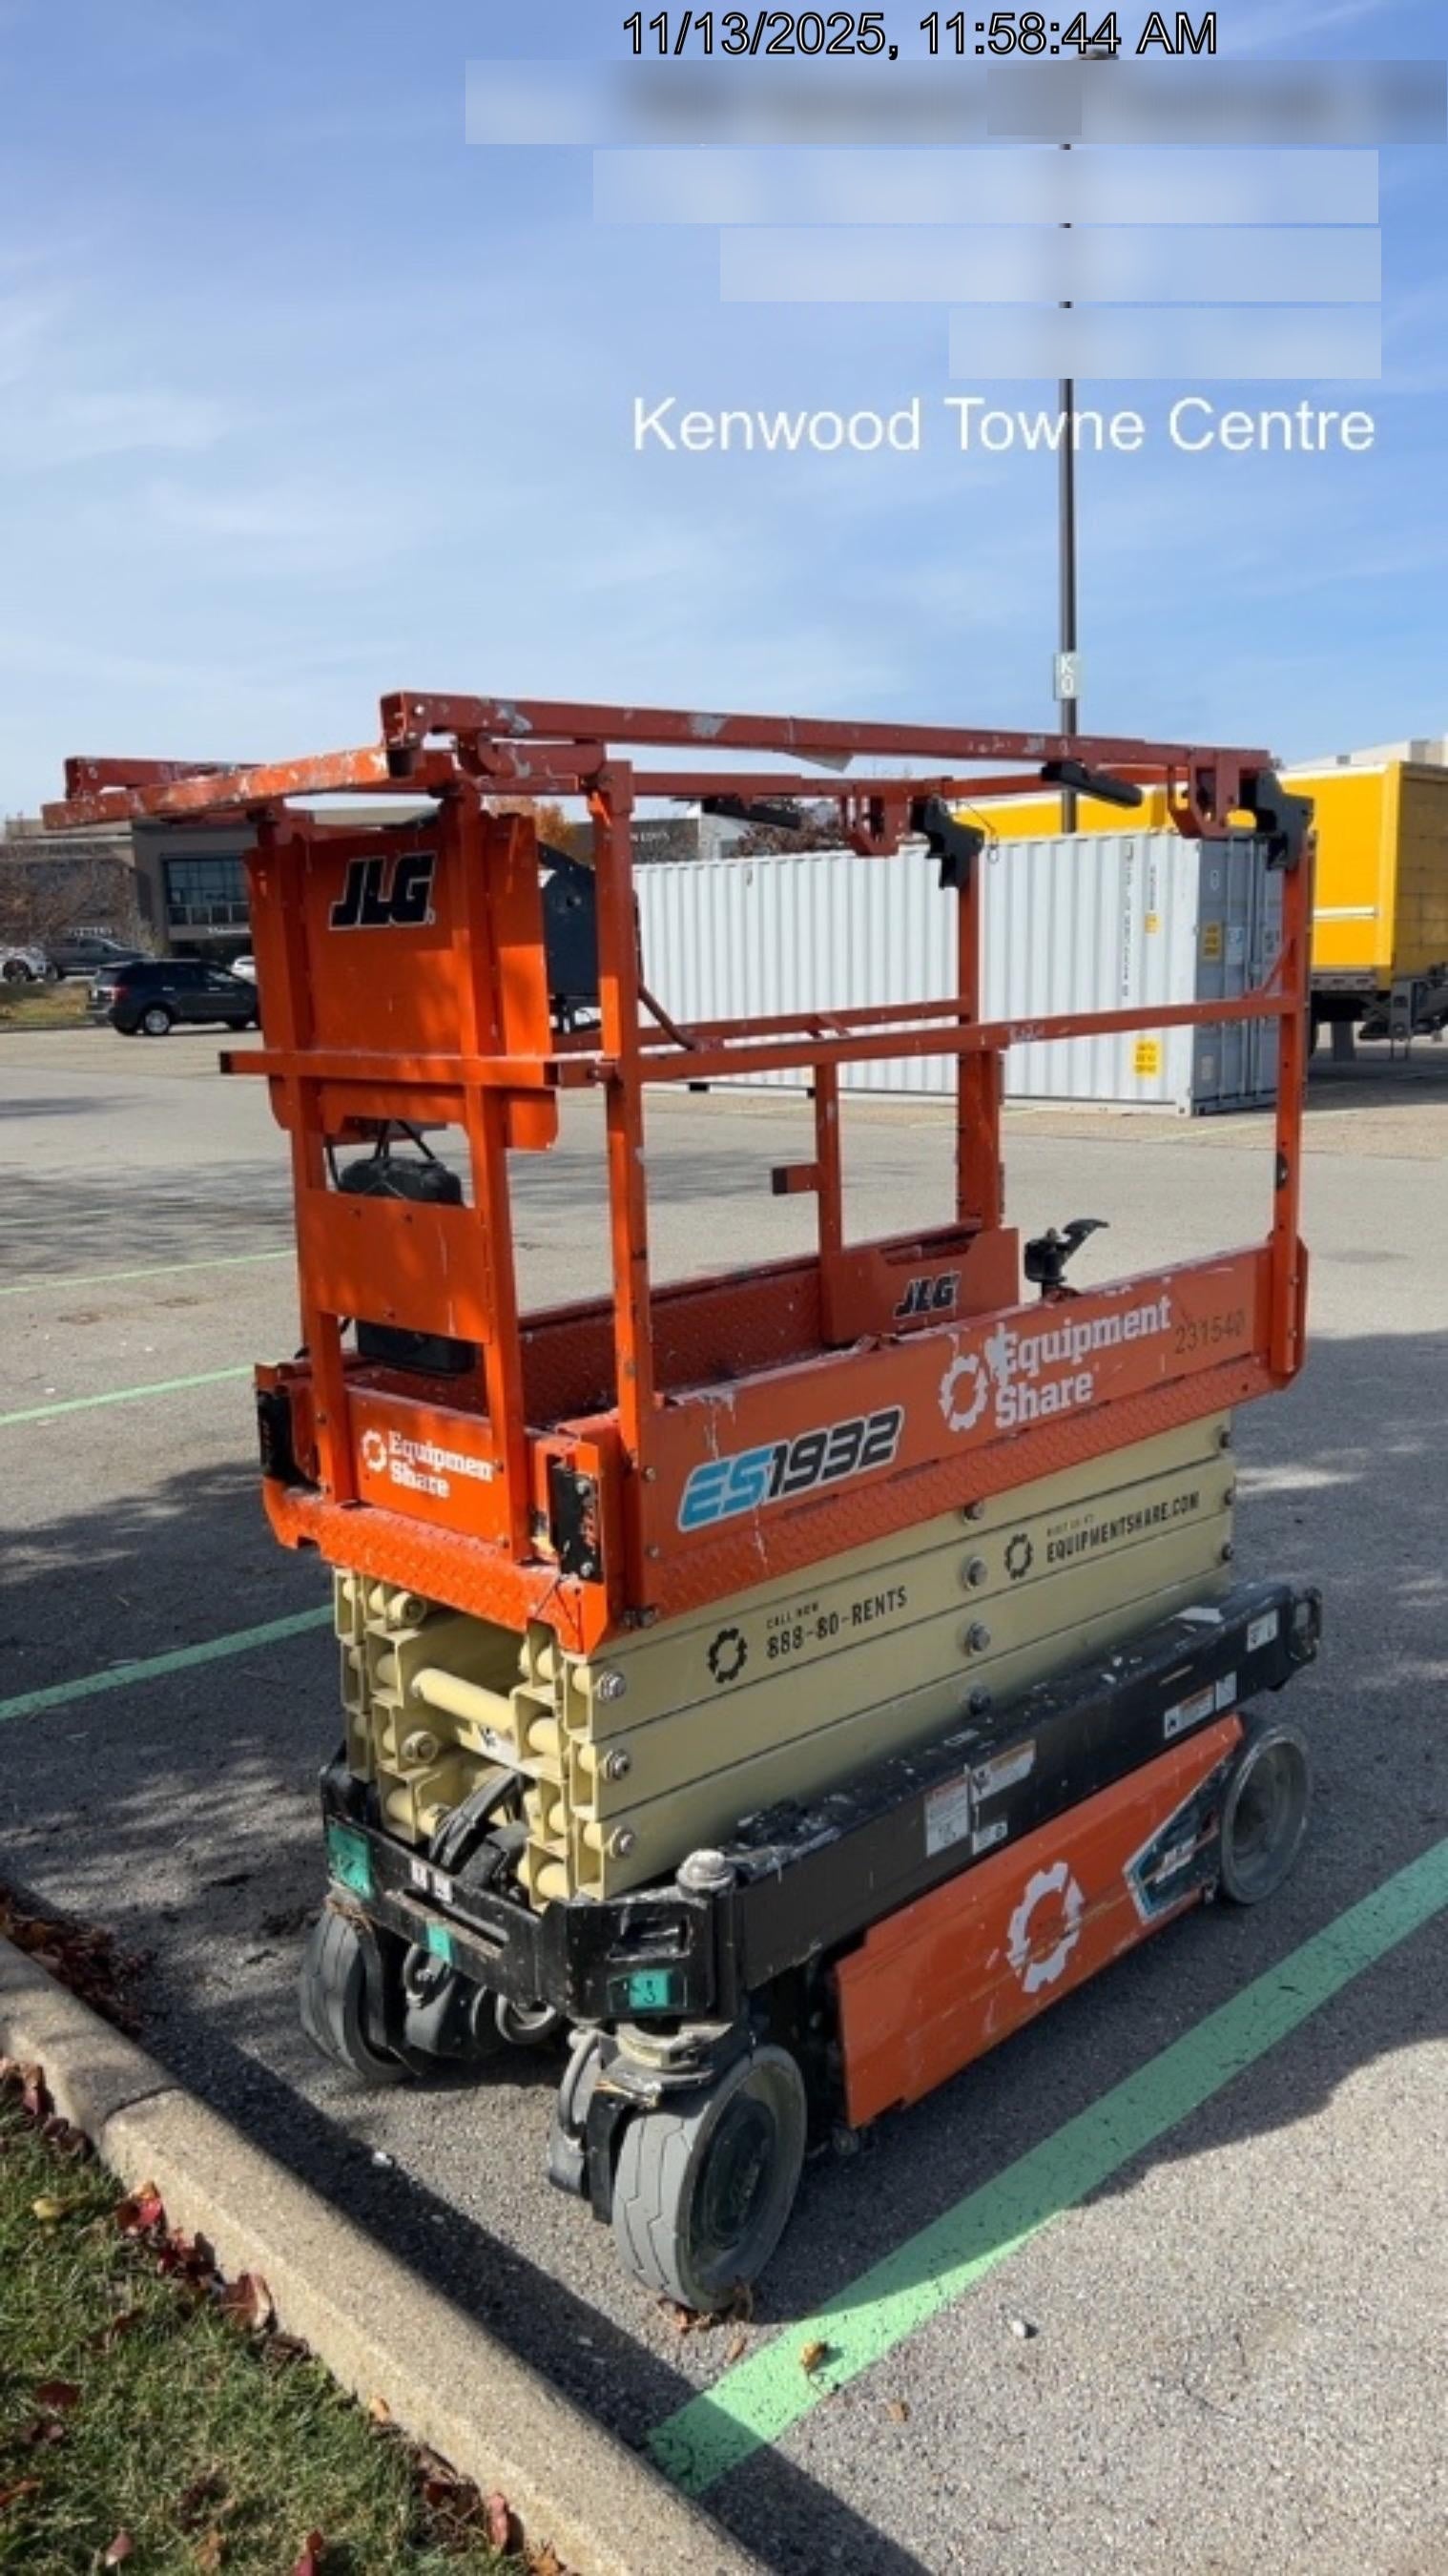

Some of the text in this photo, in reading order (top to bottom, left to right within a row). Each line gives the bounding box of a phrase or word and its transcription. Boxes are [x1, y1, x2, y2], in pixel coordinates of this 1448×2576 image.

[328, 850, 437, 931] JLG
[893, 1271, 961, 1319] JLG
[995, 1295, 1172, 1377] Equipment
[1174, 1308, 1246, 1354] 231540
[995, 1371, 1095, 1428] Share
[387, 1430, 494, 1484] Equipmen
[390, 1459, 450, 1499] Share
[680, 1407, 902, 1531] ES1932
[1046, 1490, 1200, 1564] EQUIPMENTSHARE.COM
[766, 1585, 908, 1659] 888-80-RENTS
